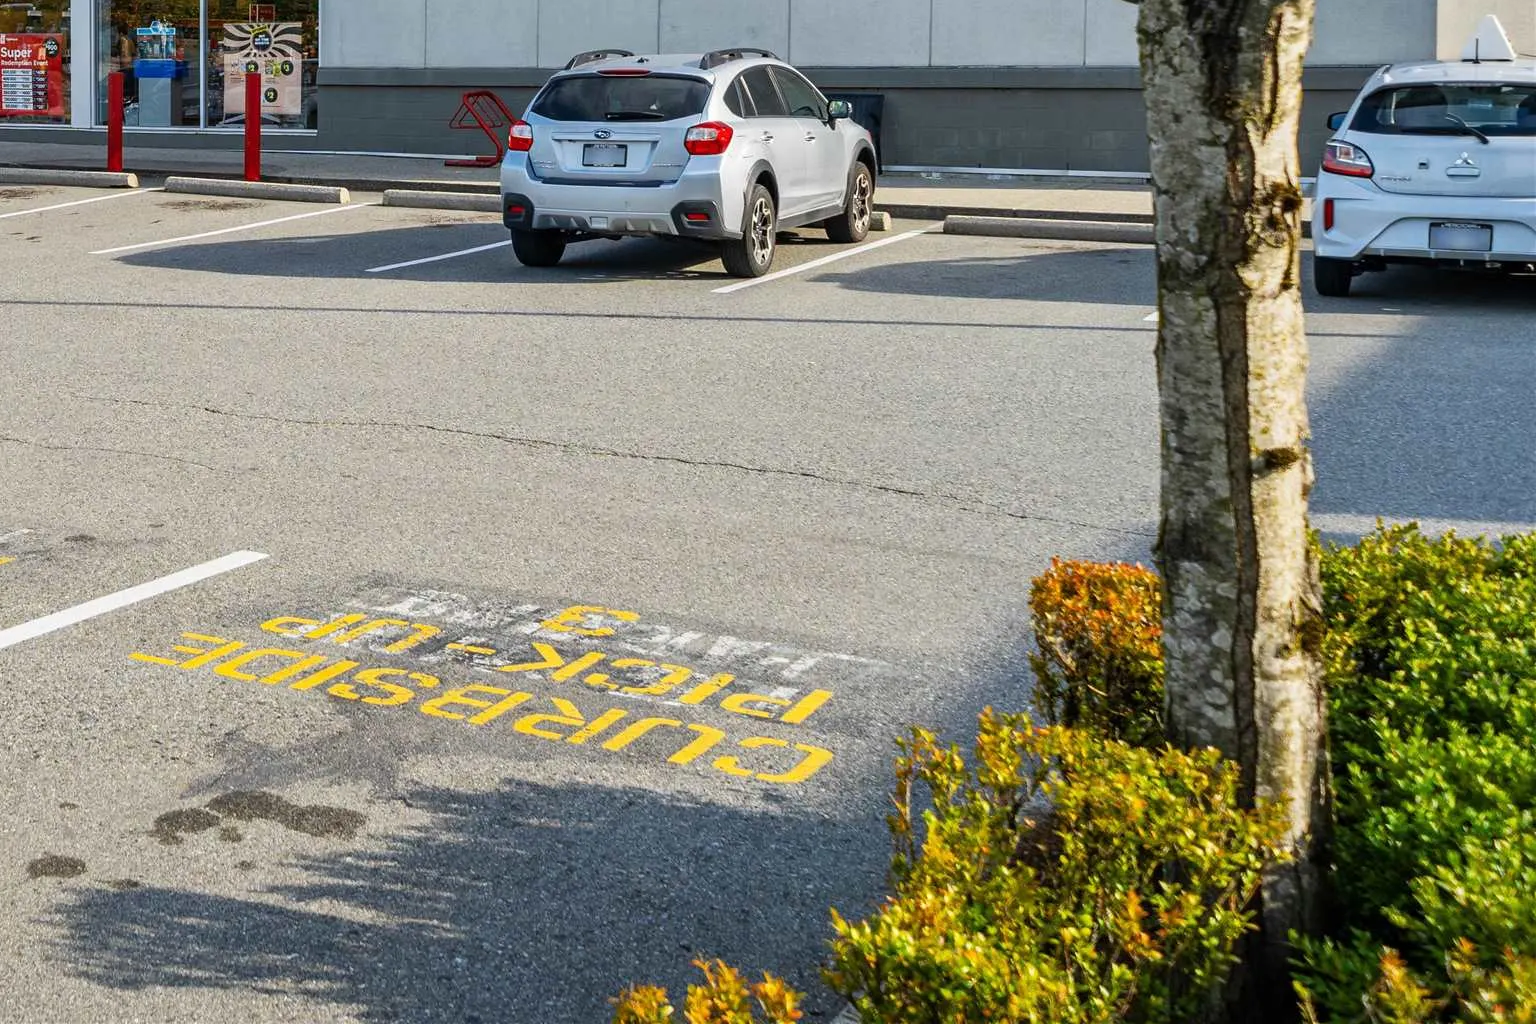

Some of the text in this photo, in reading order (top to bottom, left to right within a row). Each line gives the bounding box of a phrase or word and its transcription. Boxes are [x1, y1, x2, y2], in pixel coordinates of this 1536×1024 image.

[0, 46, 33, 61] Super
[0, 60, 33, 68] Redemption
[542, 605, 642, 638] 3
[260, 613, 833, 726] PICK-UP
[128, 631, 835, 784] CURBSIDE
